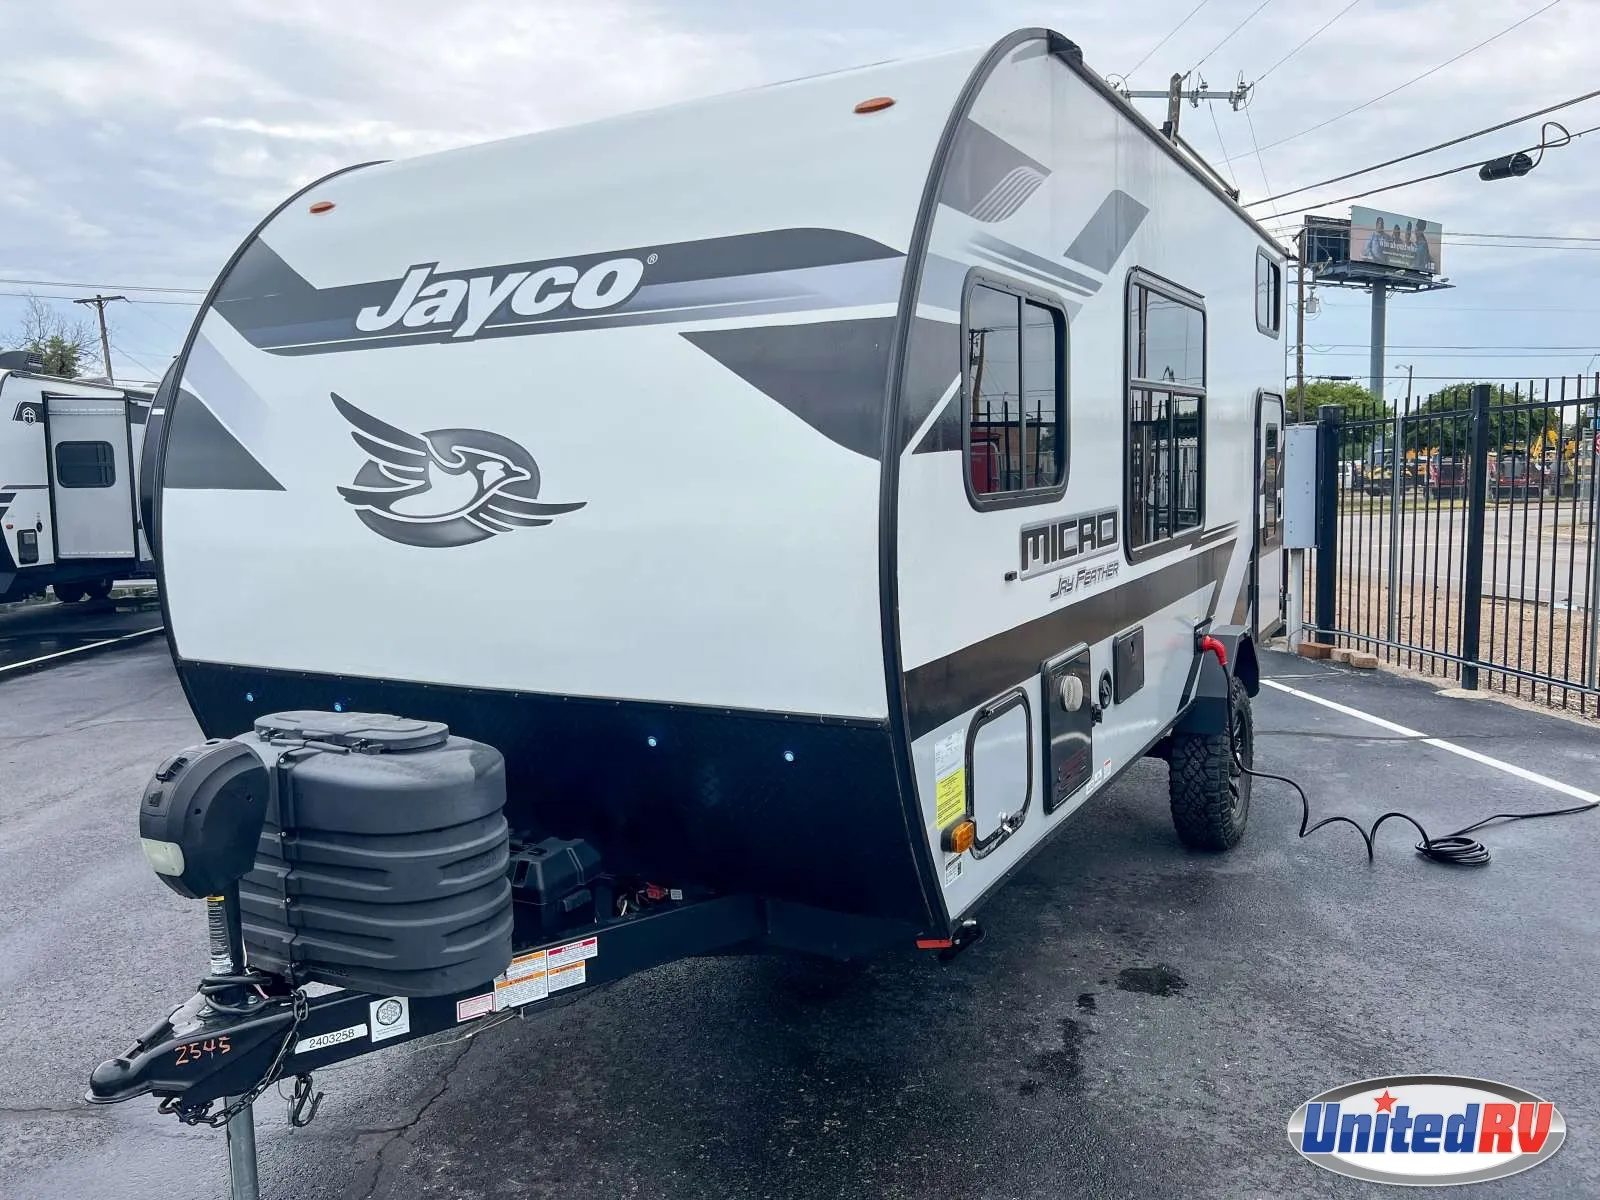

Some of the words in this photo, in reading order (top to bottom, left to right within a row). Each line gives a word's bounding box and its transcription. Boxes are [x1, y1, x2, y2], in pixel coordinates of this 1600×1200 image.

[355, 257, 644, 338] Jayco
[1021, 511, 1118, 571] MICRO
[174, 1036, 231, 1066] 2545
[309, 1028, 355, 1049] 2403258
